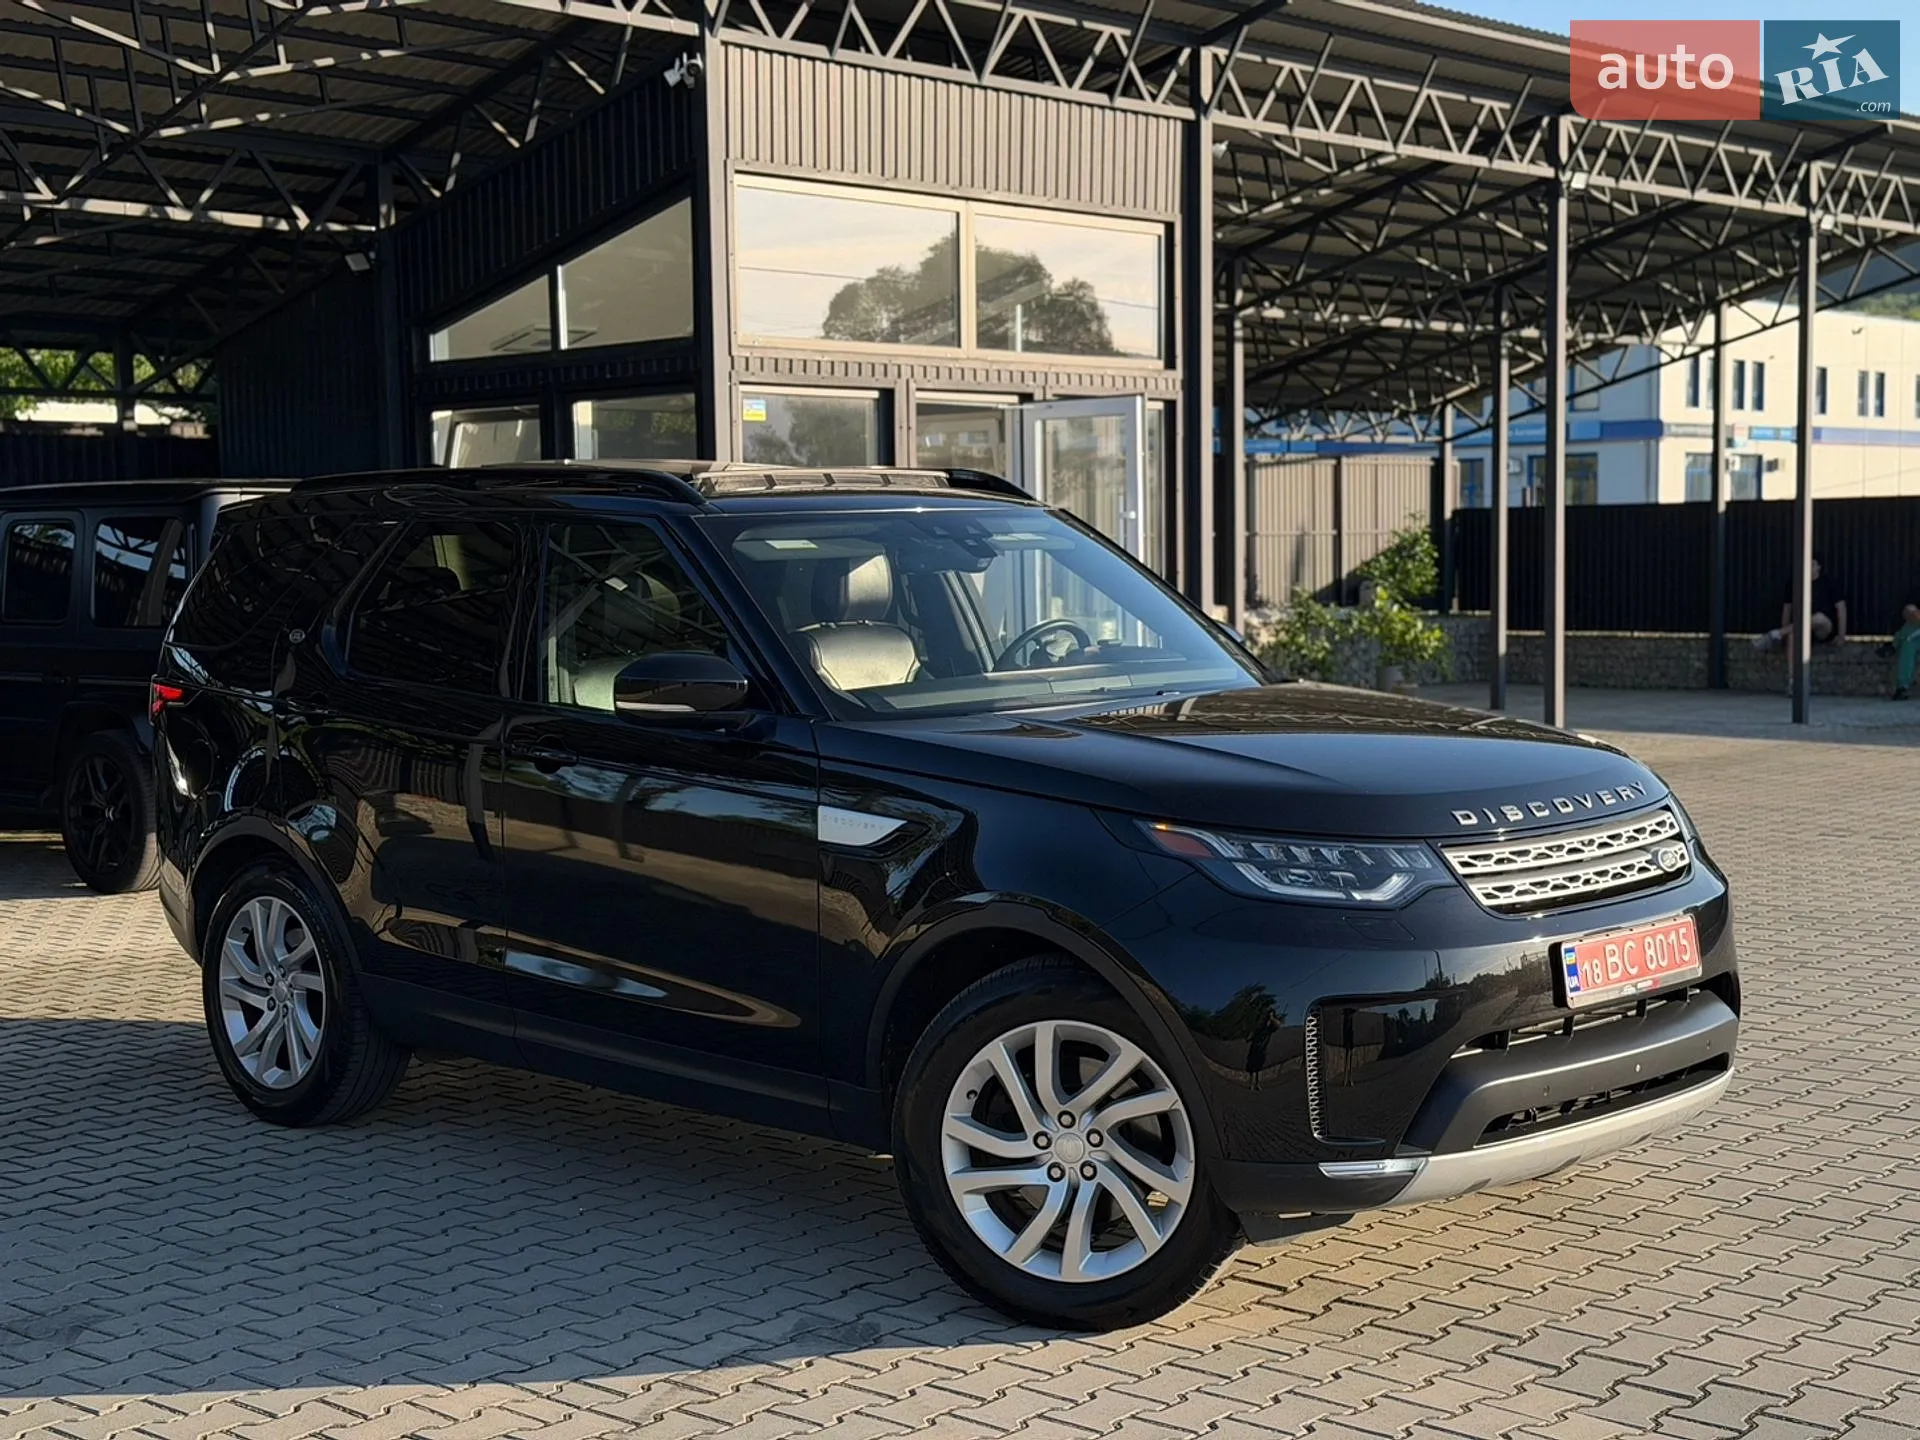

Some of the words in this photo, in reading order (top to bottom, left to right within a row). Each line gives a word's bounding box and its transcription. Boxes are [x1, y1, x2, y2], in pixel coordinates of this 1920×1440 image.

[1451, 780, 1649, 826] DISCOVERY
[1581, 958, 1603, 988] 18
[1605, 939, 1639, 981] BC
[1643, 927, 1692, 971] 8015
